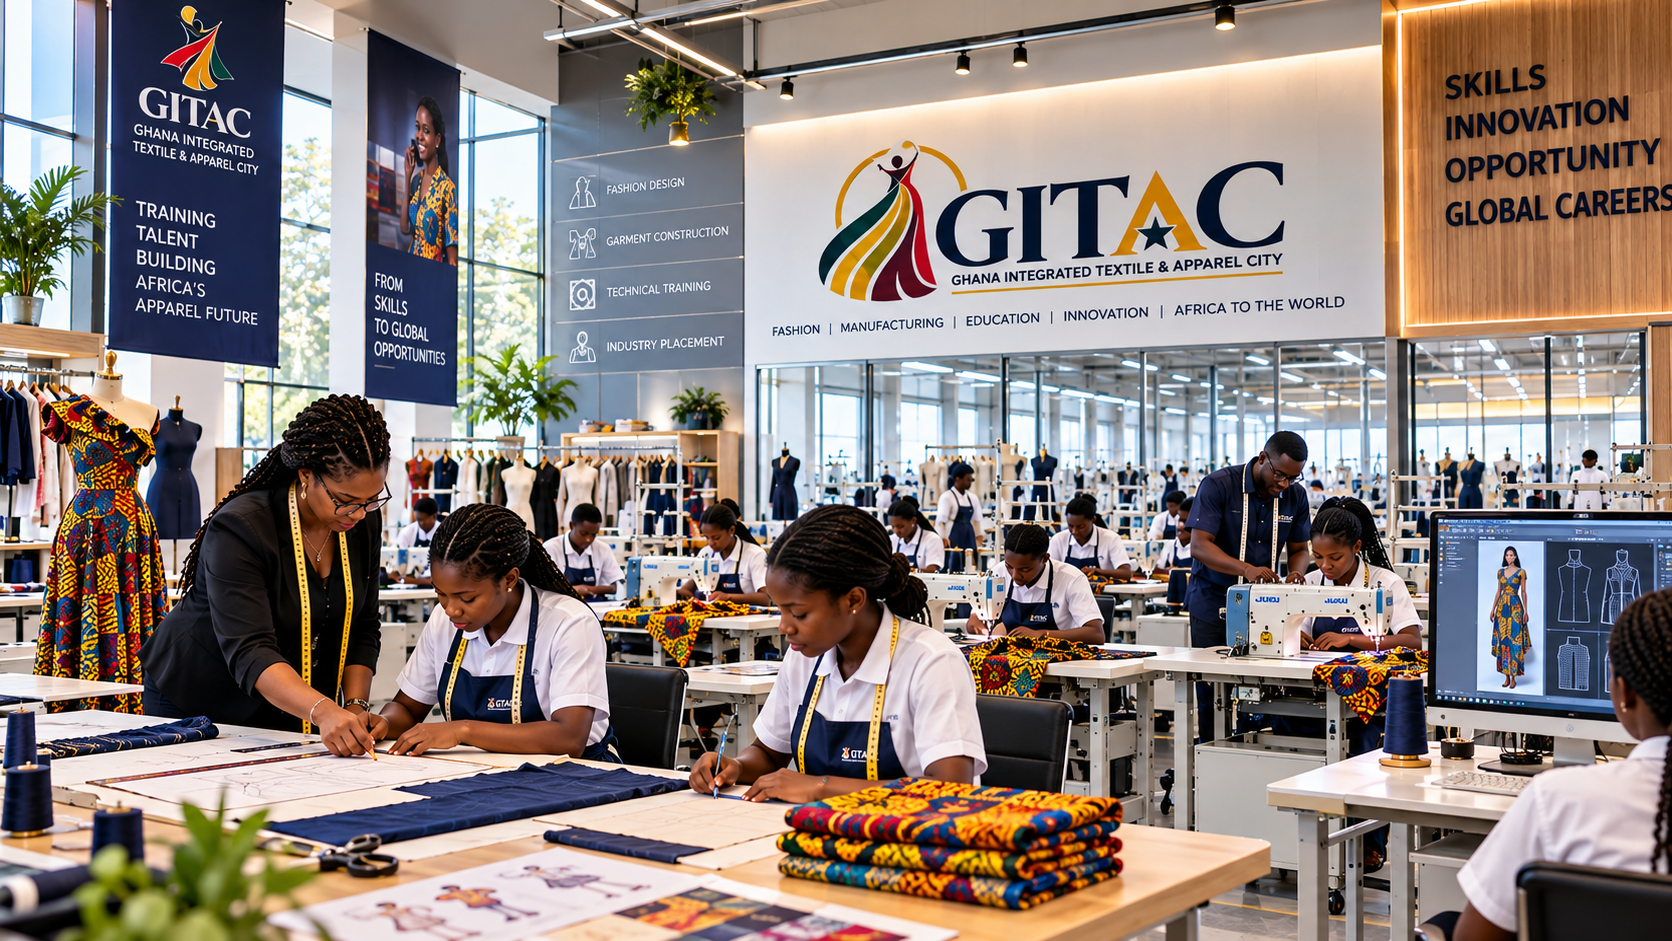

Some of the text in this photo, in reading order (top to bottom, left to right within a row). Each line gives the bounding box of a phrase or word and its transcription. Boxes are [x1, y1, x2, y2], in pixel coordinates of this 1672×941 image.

[1445, 64, 1546, 100] SKILLS
[138, 86, 251, 139] GITAC
[1446, 95, 1630, 141] INNOVATION
[133, 123, 255, 159] GHANA INTEGRATED
[132, 140, 259, 175] TEXTILE & APPAREL CITY
[1445, 138, 1662, 183] OPPORTUNITY
[606, 177, 685, 195] FASHION DESIGN
[135, 200, 216, 229] TRAINING
[935, 161, 1286, 268] GITAC
[1445, 184, 1672, 227] GLOBAL CAREERS
[135, 224, 199, 249] TALENT
[606, 226, 729, 247] GARMENT CONSTRUCTION
[136, 249, 216, 276] BUILDING
[951, 252, 1284, 286] GHANA INTEGRATED TEXTILE & APPAREL CITY
[135, 274, 206, 298] AFRICA'S
[375, 272, 403, 293] FROM
[607, 280, 711, 298] TECHNICAL TRAINING
[135, 297, 258, 326] APPAREL FUTURE
[374, 294, 408, 316] SKILLS
[771, 324, 821, 337] FASHION
[840, 317, 944, 333] MANUFACTURING
[965, 312, 1040, 327] EDUCATION
[1063, 306, 1149, 322] INNOVATION
[1174, 302, 1227, 316] AFRICA
[1230, 300, 1251, 313] TO
[1255, 298, 1284, 311] THE
[1288, 296, 1345, 309] WORLD
[374, 317, 429, 342] TO GLOBAL
[606, 336, 725, 352] INDUSTRY PLACEMENT
[374, 341, 446, 365] OPPORTUNITIES
